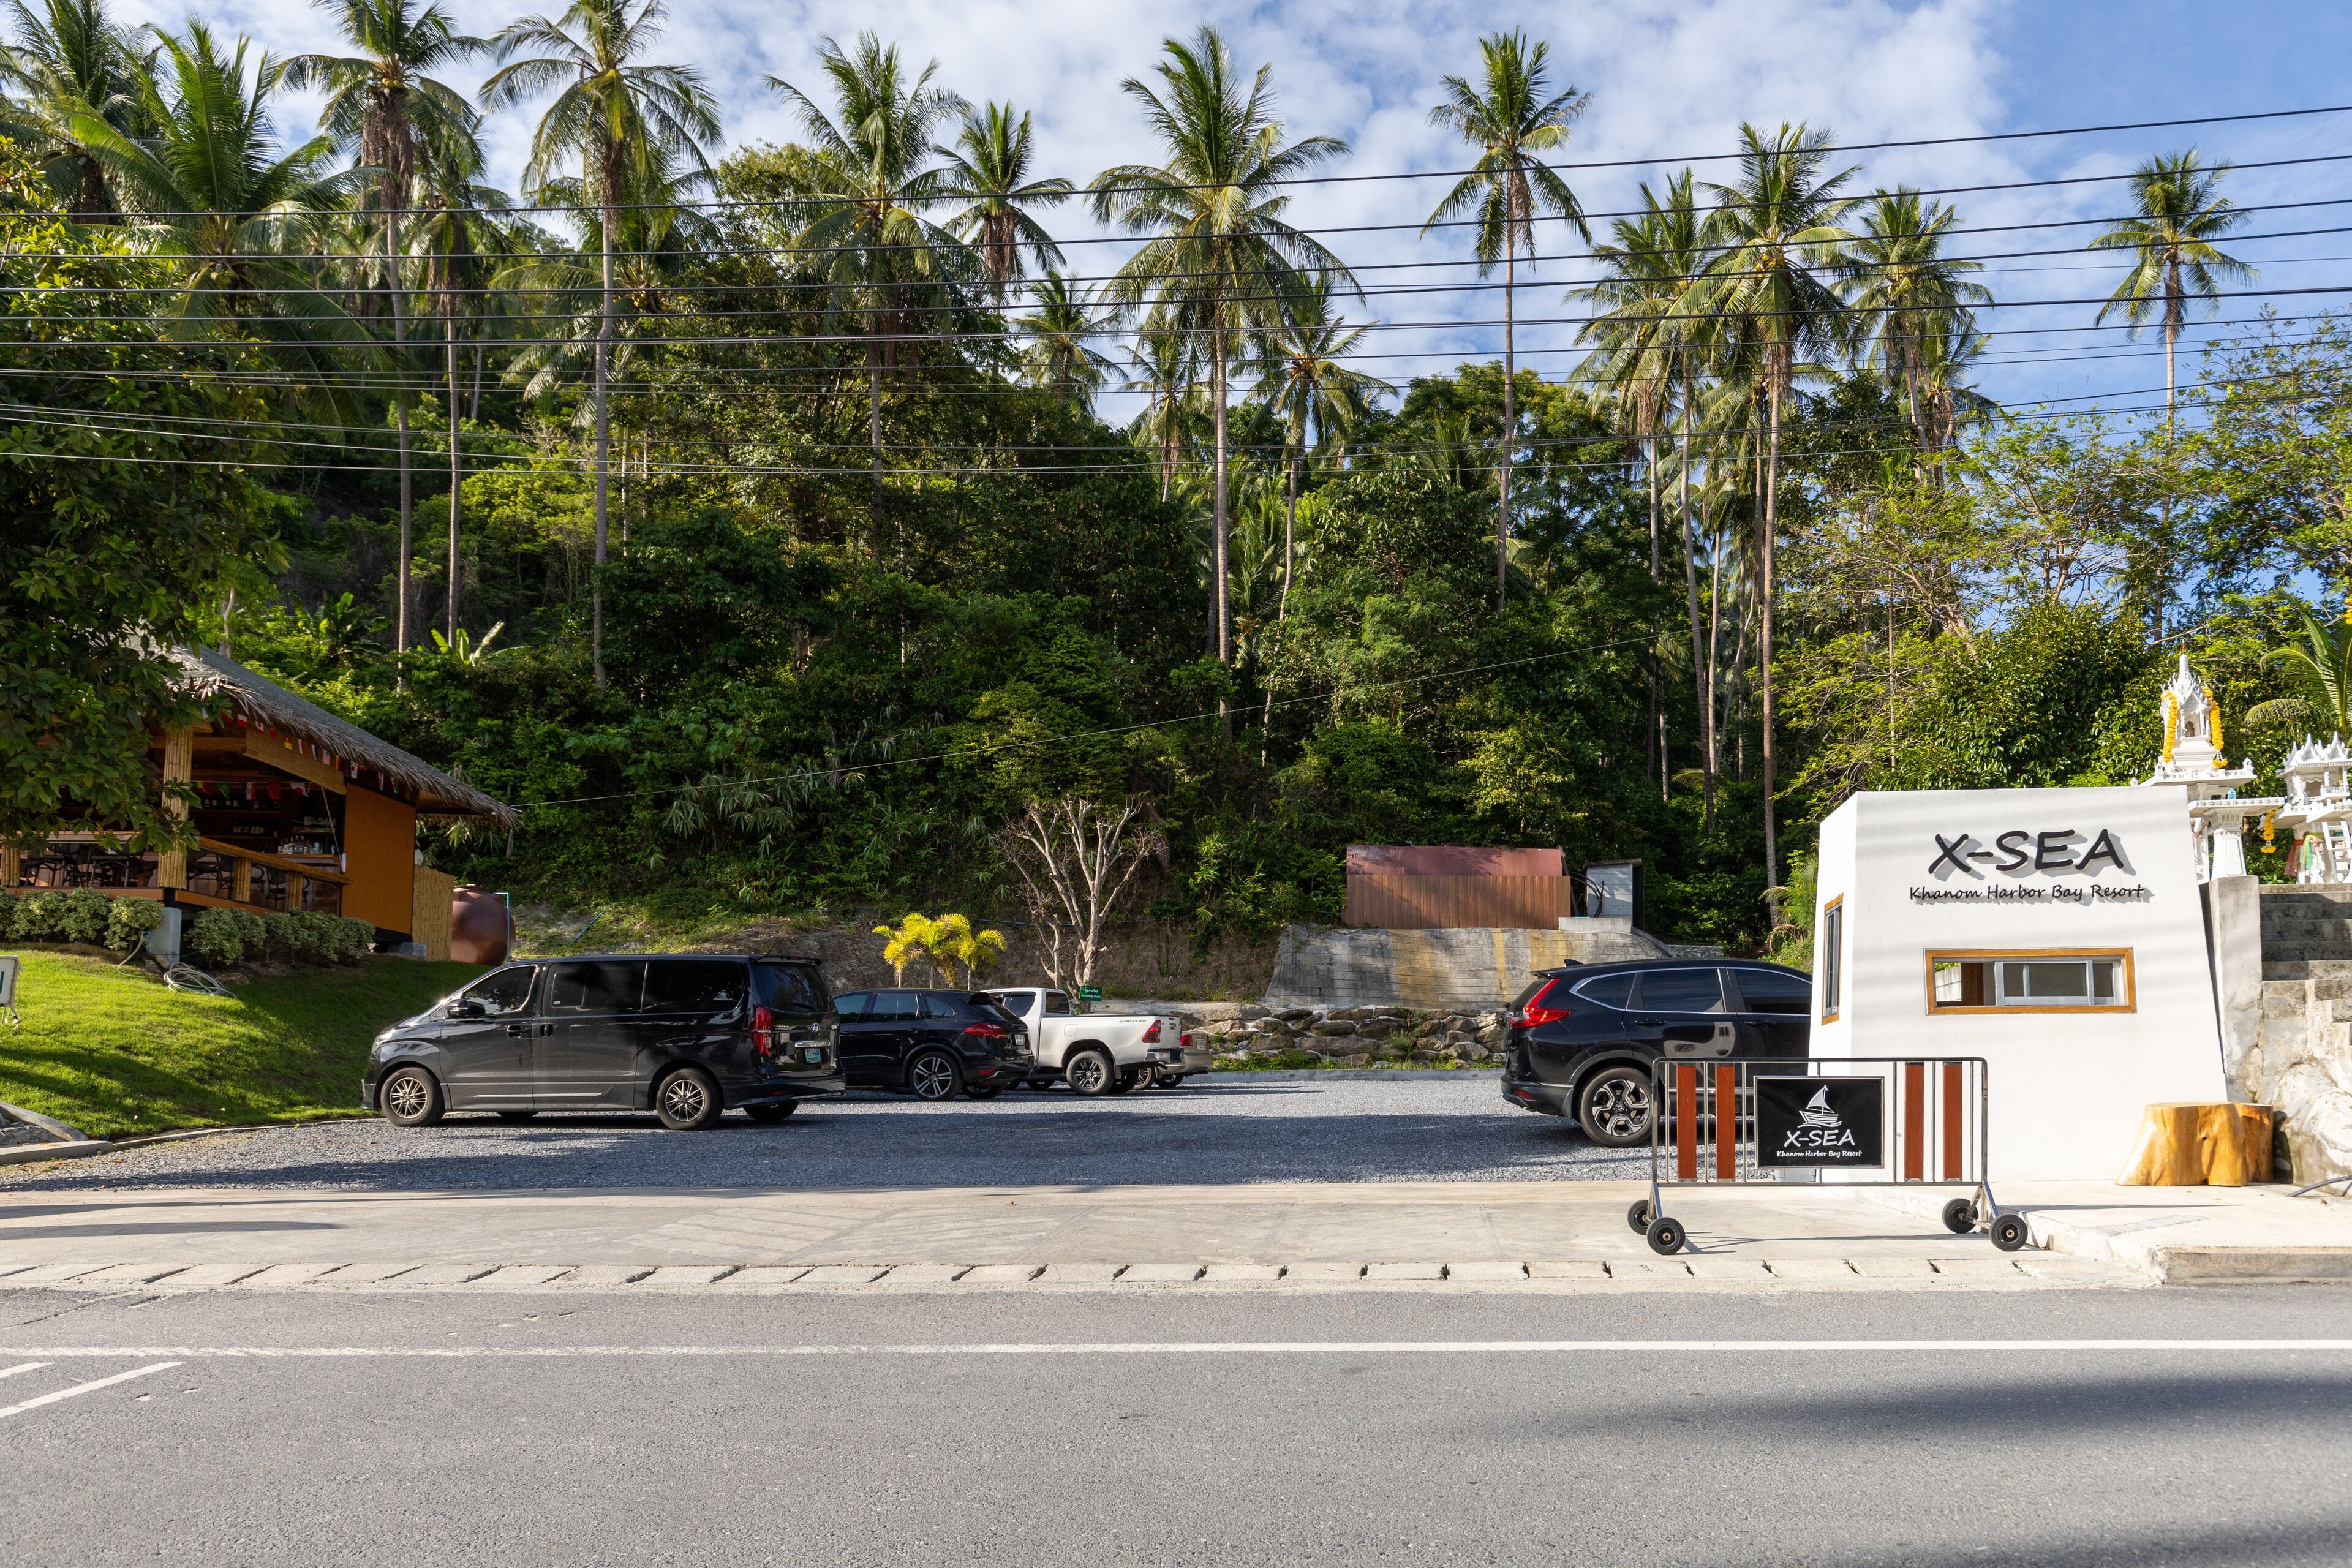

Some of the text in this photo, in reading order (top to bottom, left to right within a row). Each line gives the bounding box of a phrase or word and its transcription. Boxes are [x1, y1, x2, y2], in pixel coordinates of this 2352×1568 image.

[1928, 828, 2124, 875] X-SEA
[1910, 884, 2145, 902] Khanom Harbor Bay Resort
[1784, 1129, 1856, 1147] X-SEA
